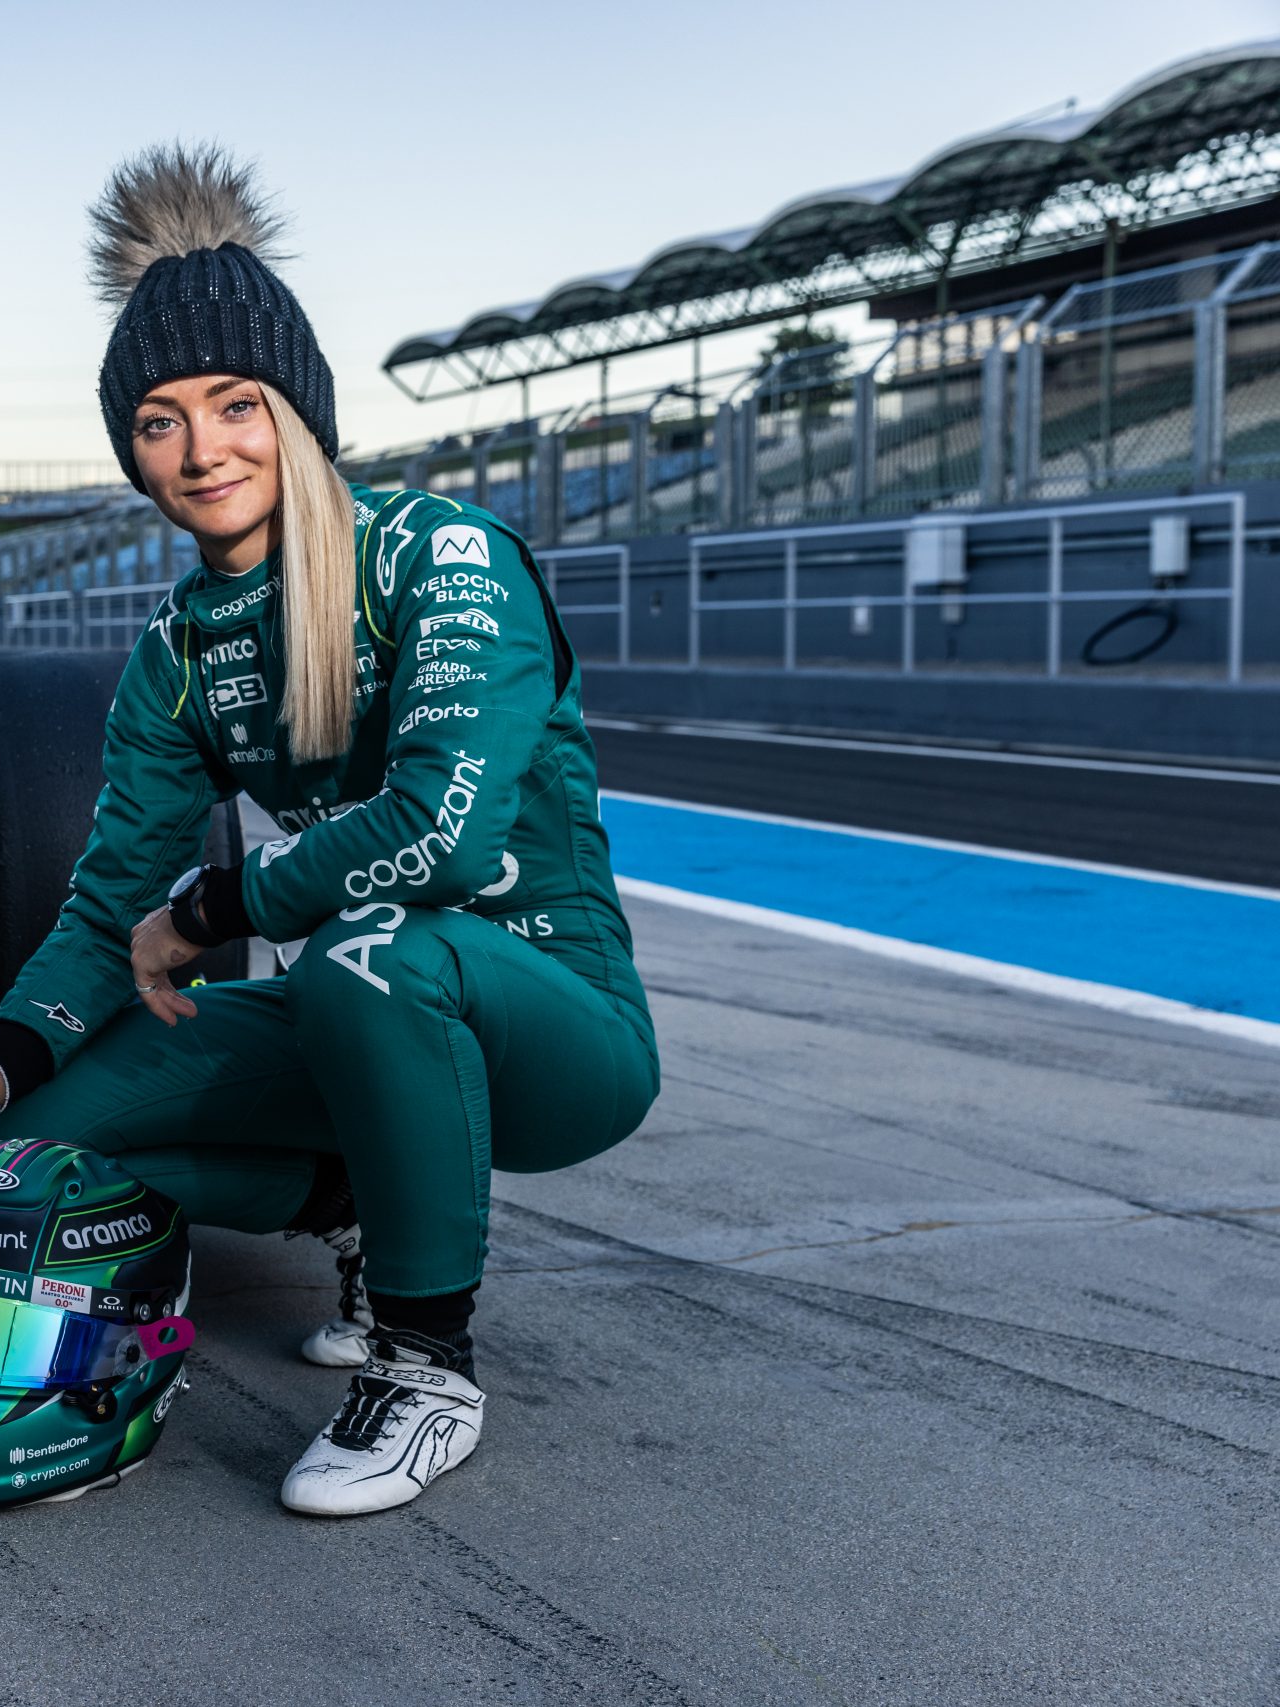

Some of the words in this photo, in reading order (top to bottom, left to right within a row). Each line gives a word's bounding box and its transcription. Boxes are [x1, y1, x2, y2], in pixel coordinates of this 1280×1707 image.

[412, 572, 509, 602] VELOCITY
[436, 589, 493, 604] BLACK
[417, 660, 470, 674] GIRARD
[345, 750, 486, 898] cognizant
[62, 1213, 152, 1249] aramco
[41, 1278, 86, 1298] PERONI
[26, 1434, 89, 1459] SentinelOne
[30, 1456, 90, 1482] crypto.com
